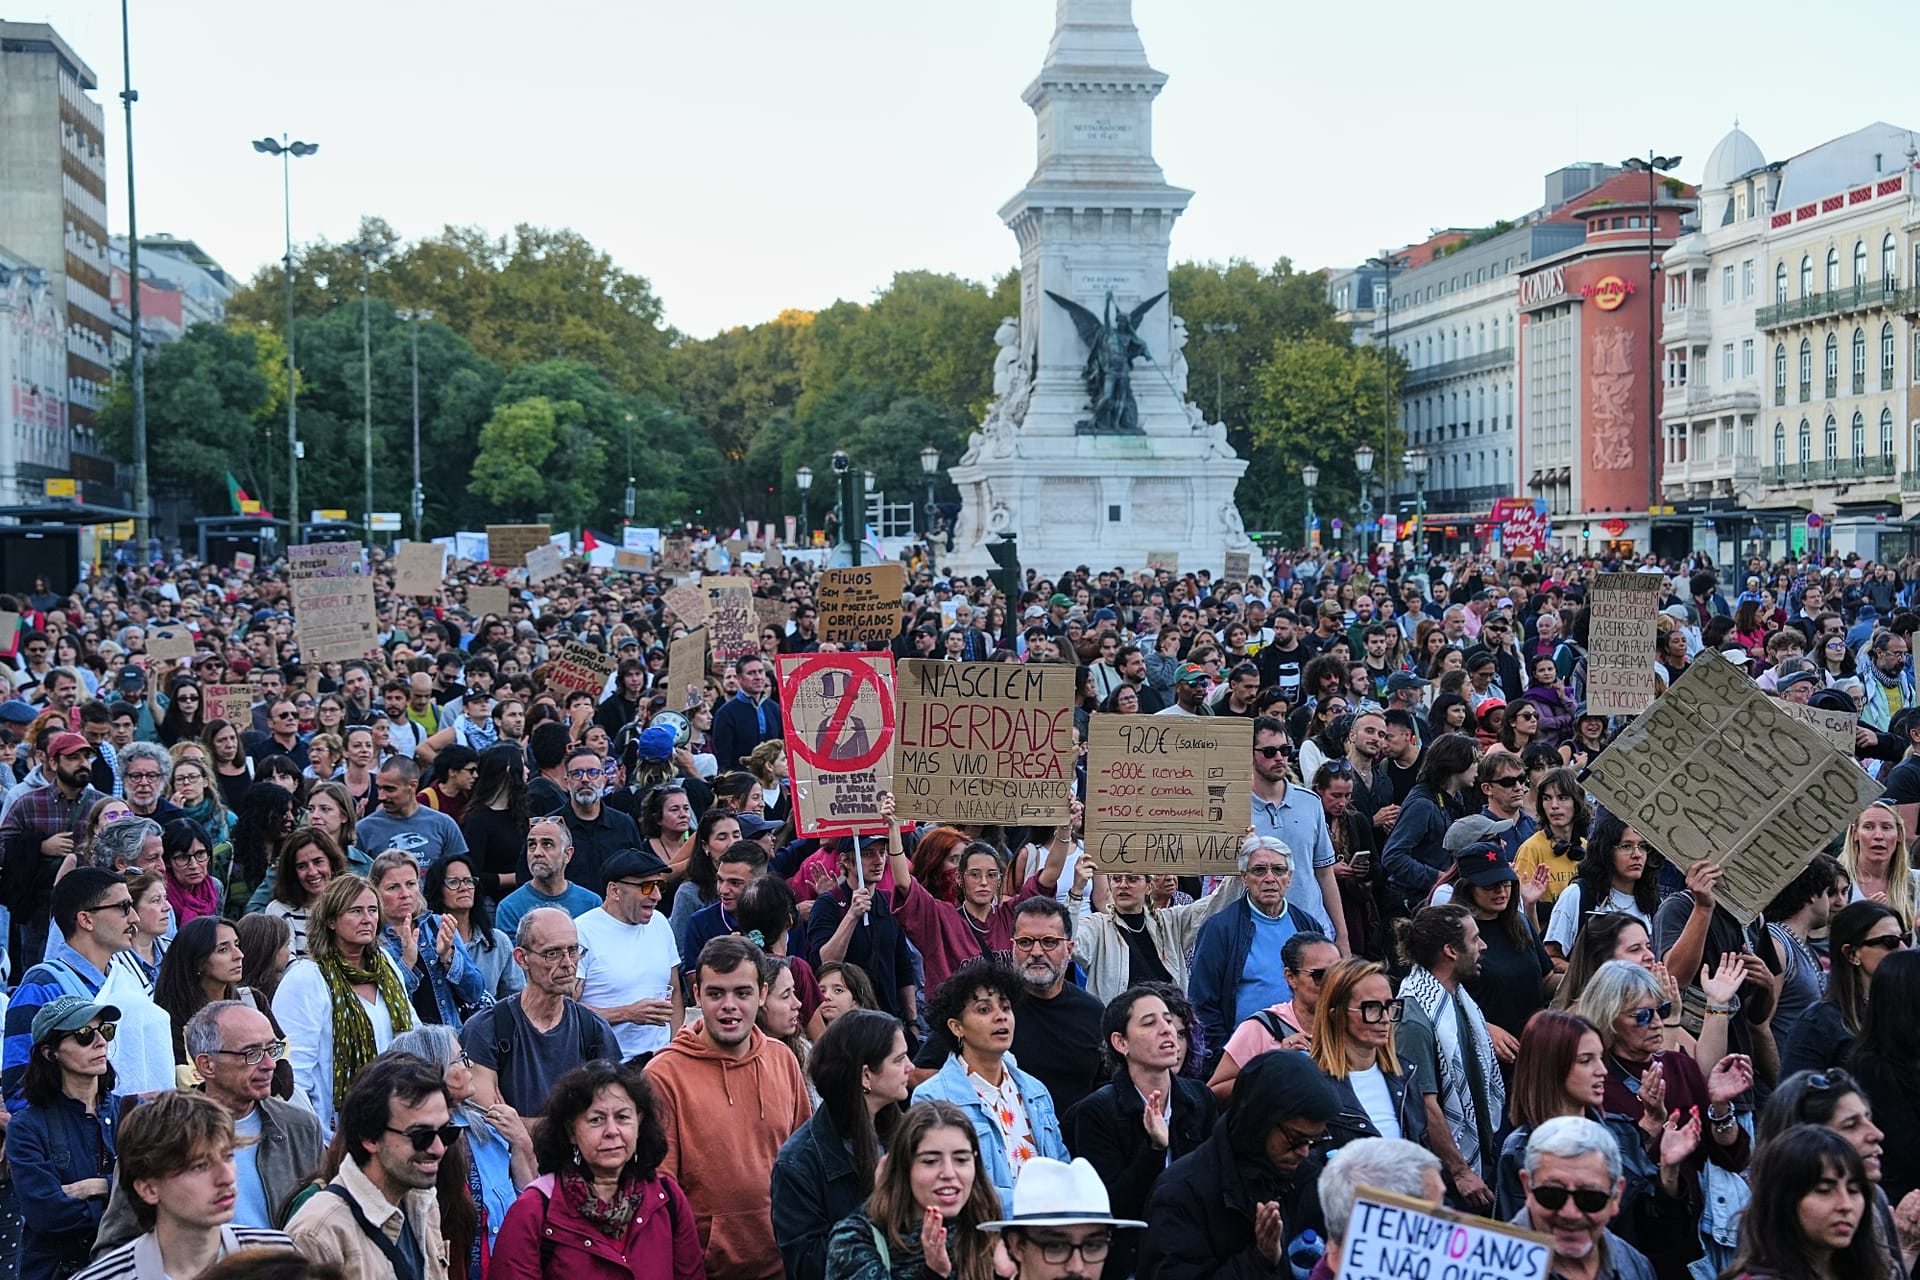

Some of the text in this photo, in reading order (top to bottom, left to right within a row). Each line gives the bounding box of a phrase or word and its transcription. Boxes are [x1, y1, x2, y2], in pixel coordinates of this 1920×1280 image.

[1521, 265, 1567, 305] CONDES
[1581, 280, 1636, 297] Hard Rock
[830, 570, 872, 585] FILHOS
[821, 586, 839, 598] SEM
[1592, 590, 1618, 603] LUTA
[820, 600, 838, 612] SEM
[842, 602, 866, 612] PODER
[1592, 603, 1656, 620] QUEM EXPLORA
[828, 612, 895, 627] OBRIGADOS
[826, 626, 893, 642] EMIGRAR
[1594, 620, 1649, 638] A REPRESSÃO
[567, 643, 606, 663] ABAIXO O
[1631, 641, 1656, 654] FALHA
[563, 652, 612, 676] CAPITALISMO
[1589, 653, 1648, 670] DO SISTEMA
[552, 670, 603, 697] HABITAÇÃO
[920, 664, 1044, 702] NASCI EM
[1601, 670, 1609, 685] O
[1611, 671, 1655, 688] SISTEMA
[1592, 690, 1602, 707] A
[1666, 686, 1698, 716] PO
[900, 702, 1070, 754] LIBERDADE
[1118, 724, 1170, 754] 920€
[901, 750, 1063, 779] MAS VIVO PRESA
[1613, 780, 1646, 813] PO
[1638, 752, 1670, 784] PO
[1662, 727, 1697, 761] PO
[1686, 701, 1720, 733] PO
[817, 768, 877, 785] ONDE ESTÁ
[835, 785, 876, 793] A NOSSA
[905, 777, 931, 796] NO
[950, 778, 994, 796] MEU
[1003, 781, 1069, 799] QUARTO
[1150, 785, 1194, 797] comida
[1666, 727, 1812, 861] CARALHO
[835, 794, 858, 803] CASA
[861, 794, 873, 802] DE
[1638, 792, 1678, 834] PO
[1670, 762, 1710, 798] PO
[829, 802, 878, 815] PARTIDA
[926, 799, 945, 817] DE
[1144, 833, 1185, 864] PARA
[1195, 834, 1244, 861] VIVER
[1357, 1201, 1443, 1250] TENHO
[1467, 1235, 1548, 1278] ANOS
[1350, 1239, 1367, 1268] E
[1378, 1246, 1431, 1280] NÃO
